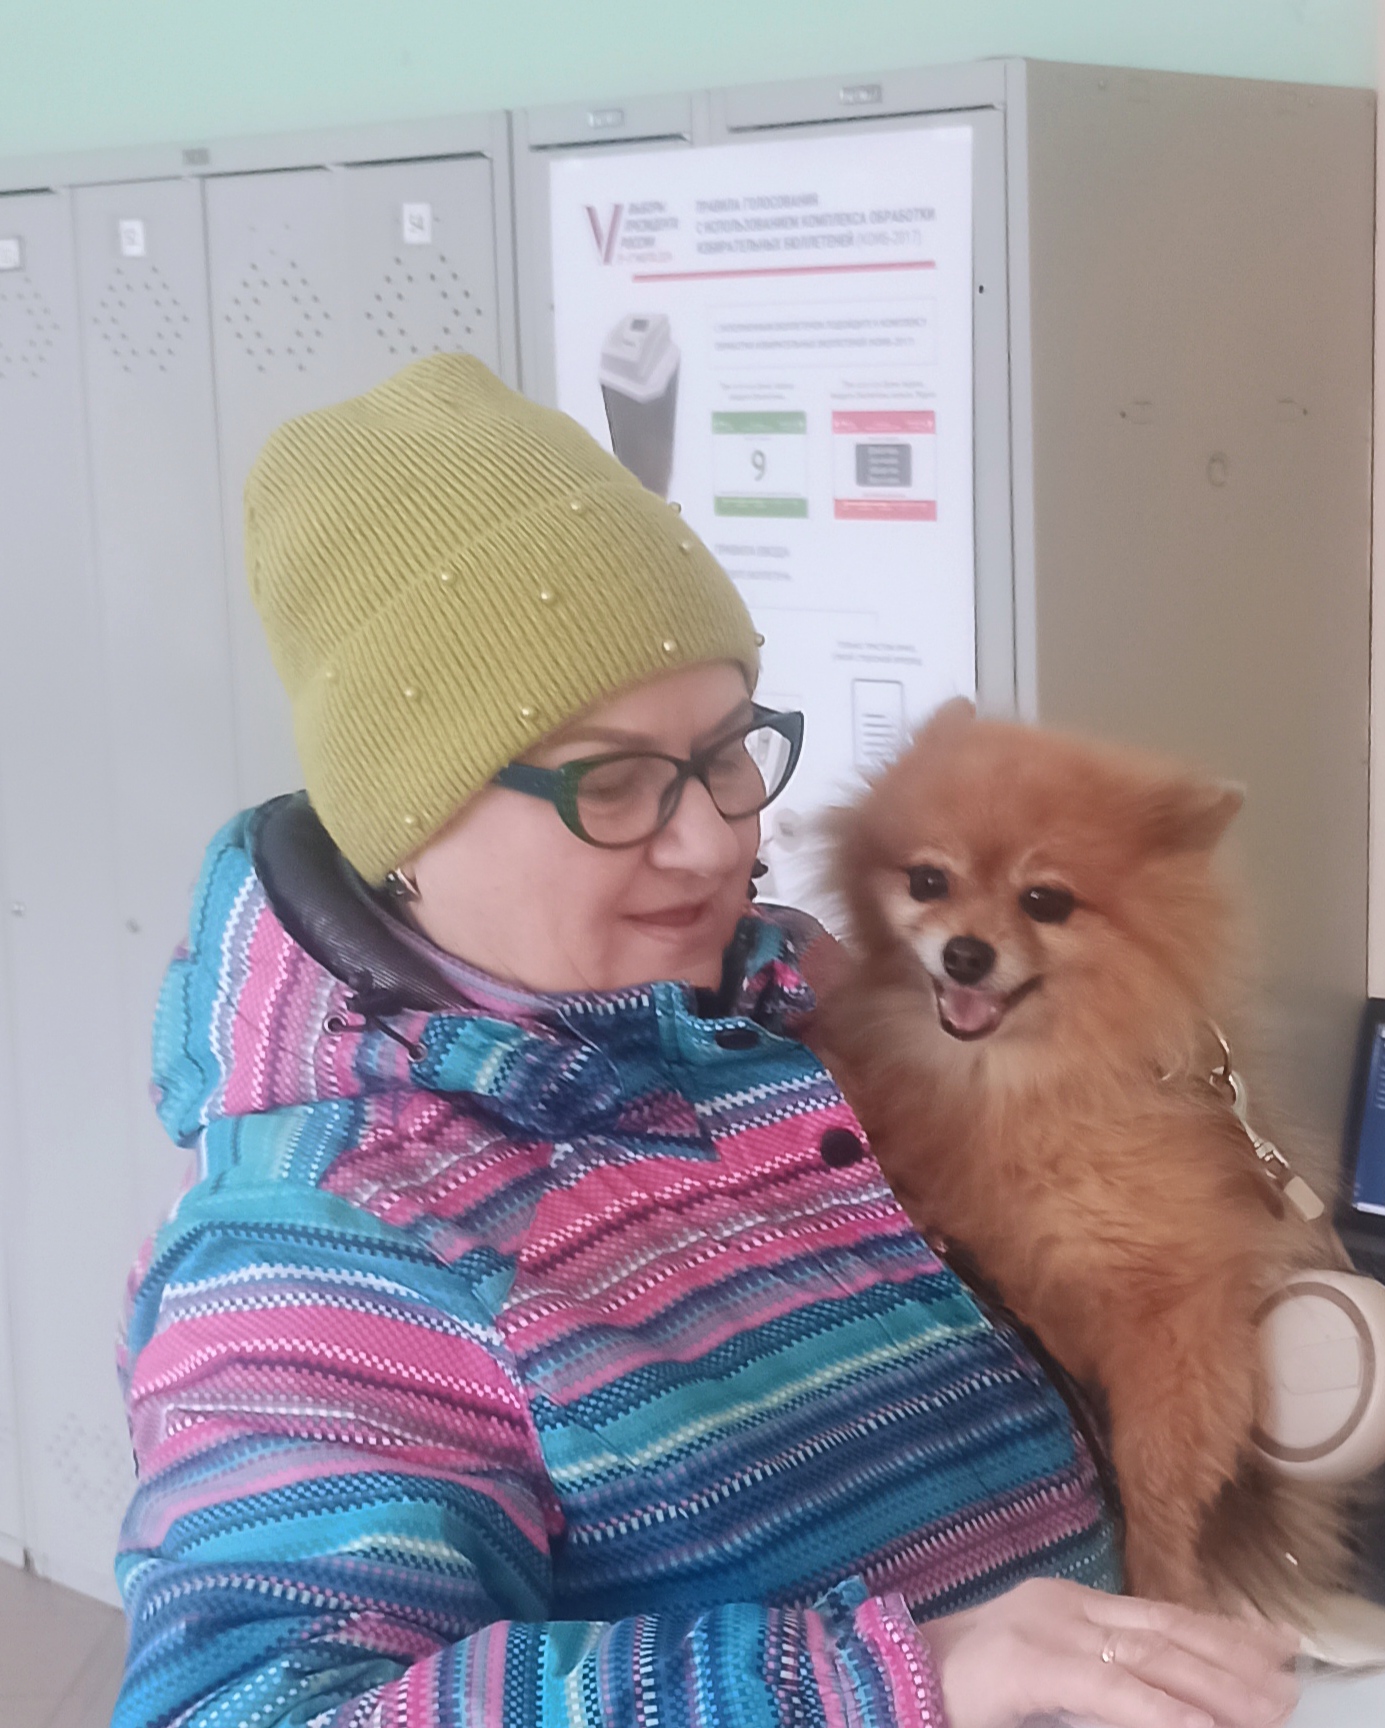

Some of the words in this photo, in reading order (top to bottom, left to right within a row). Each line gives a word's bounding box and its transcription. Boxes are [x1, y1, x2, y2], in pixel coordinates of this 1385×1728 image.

[696, 198, 740, 213] ПРАВИЛА
[743, 192, 818, 210] ГОЛОСОВАНИЯ
[802, 211, 866, 228] КОМПЛЕКСА
[869, 207, 935, 224] ОБРАБОТКИ
[784, 230, 853, 250] БЮЛЛЕТЕНЕЙ
[751, 449, 766, 481] 9
